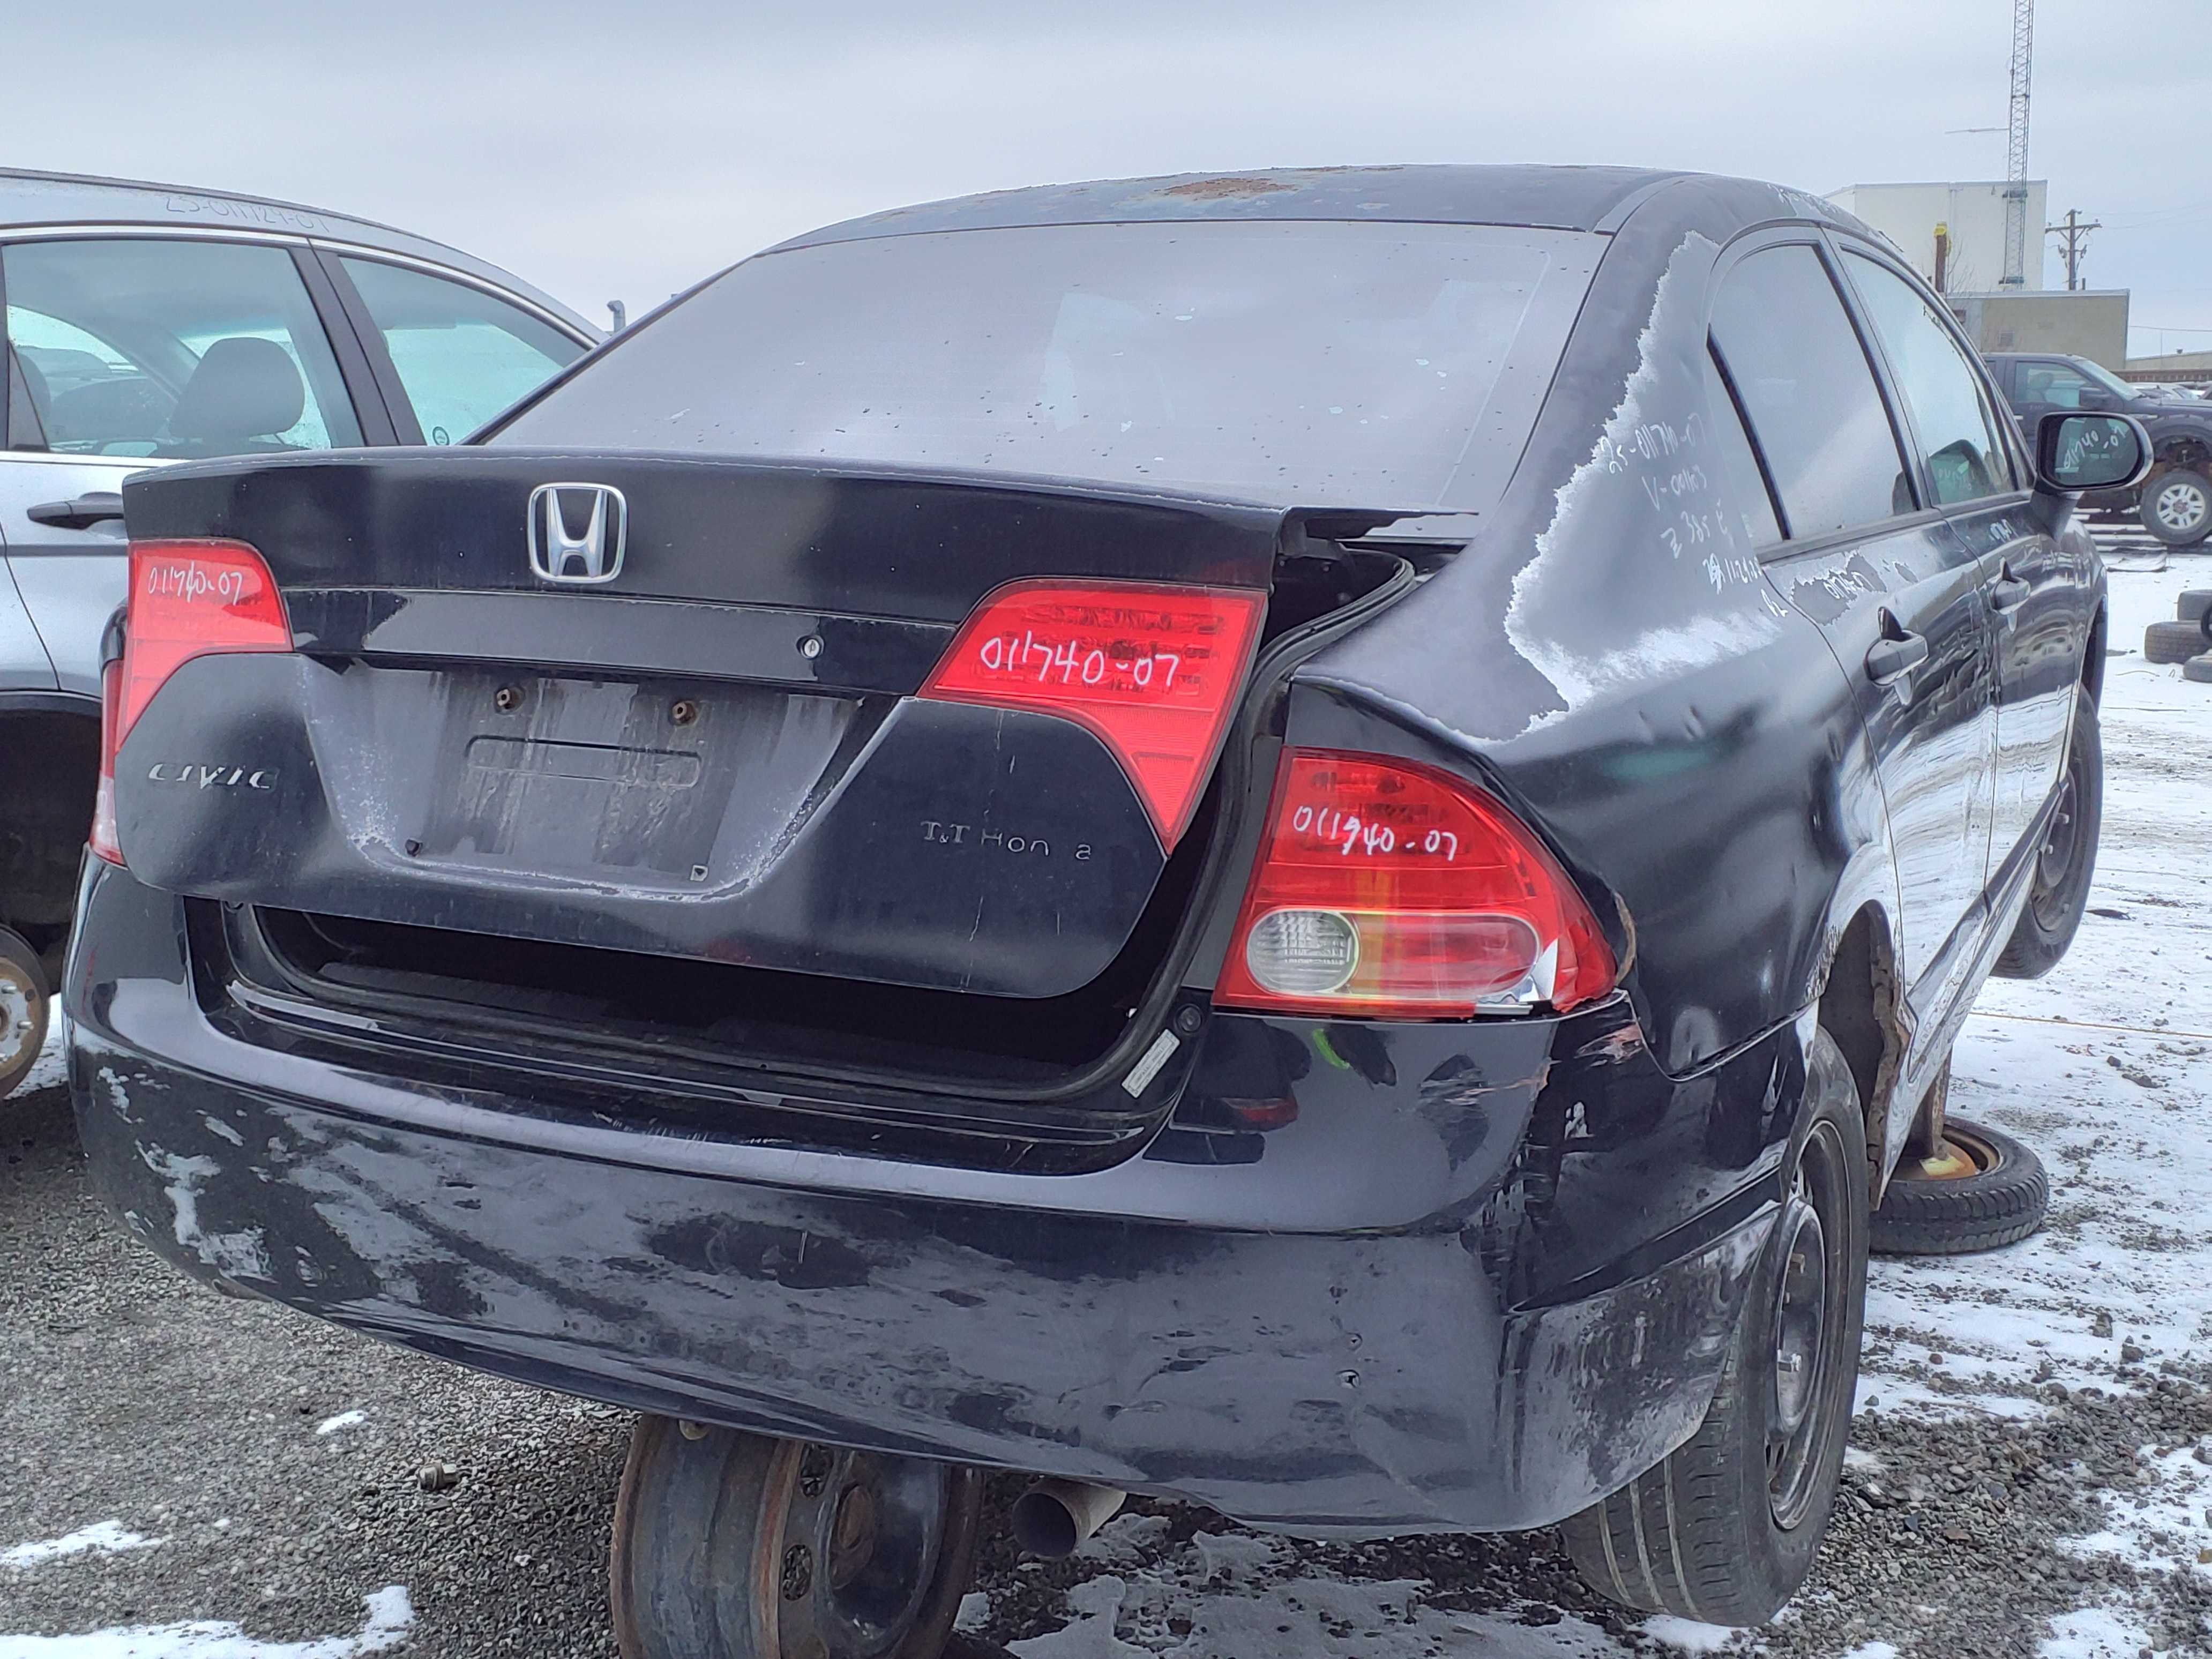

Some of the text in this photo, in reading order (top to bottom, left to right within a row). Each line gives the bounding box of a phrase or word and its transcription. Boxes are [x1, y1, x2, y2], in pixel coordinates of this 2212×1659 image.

[980, 630, 1179, 686] 011740-07
[148, 763, 278, 790] CIVIC
[920, 820, 971, 843] T&T
